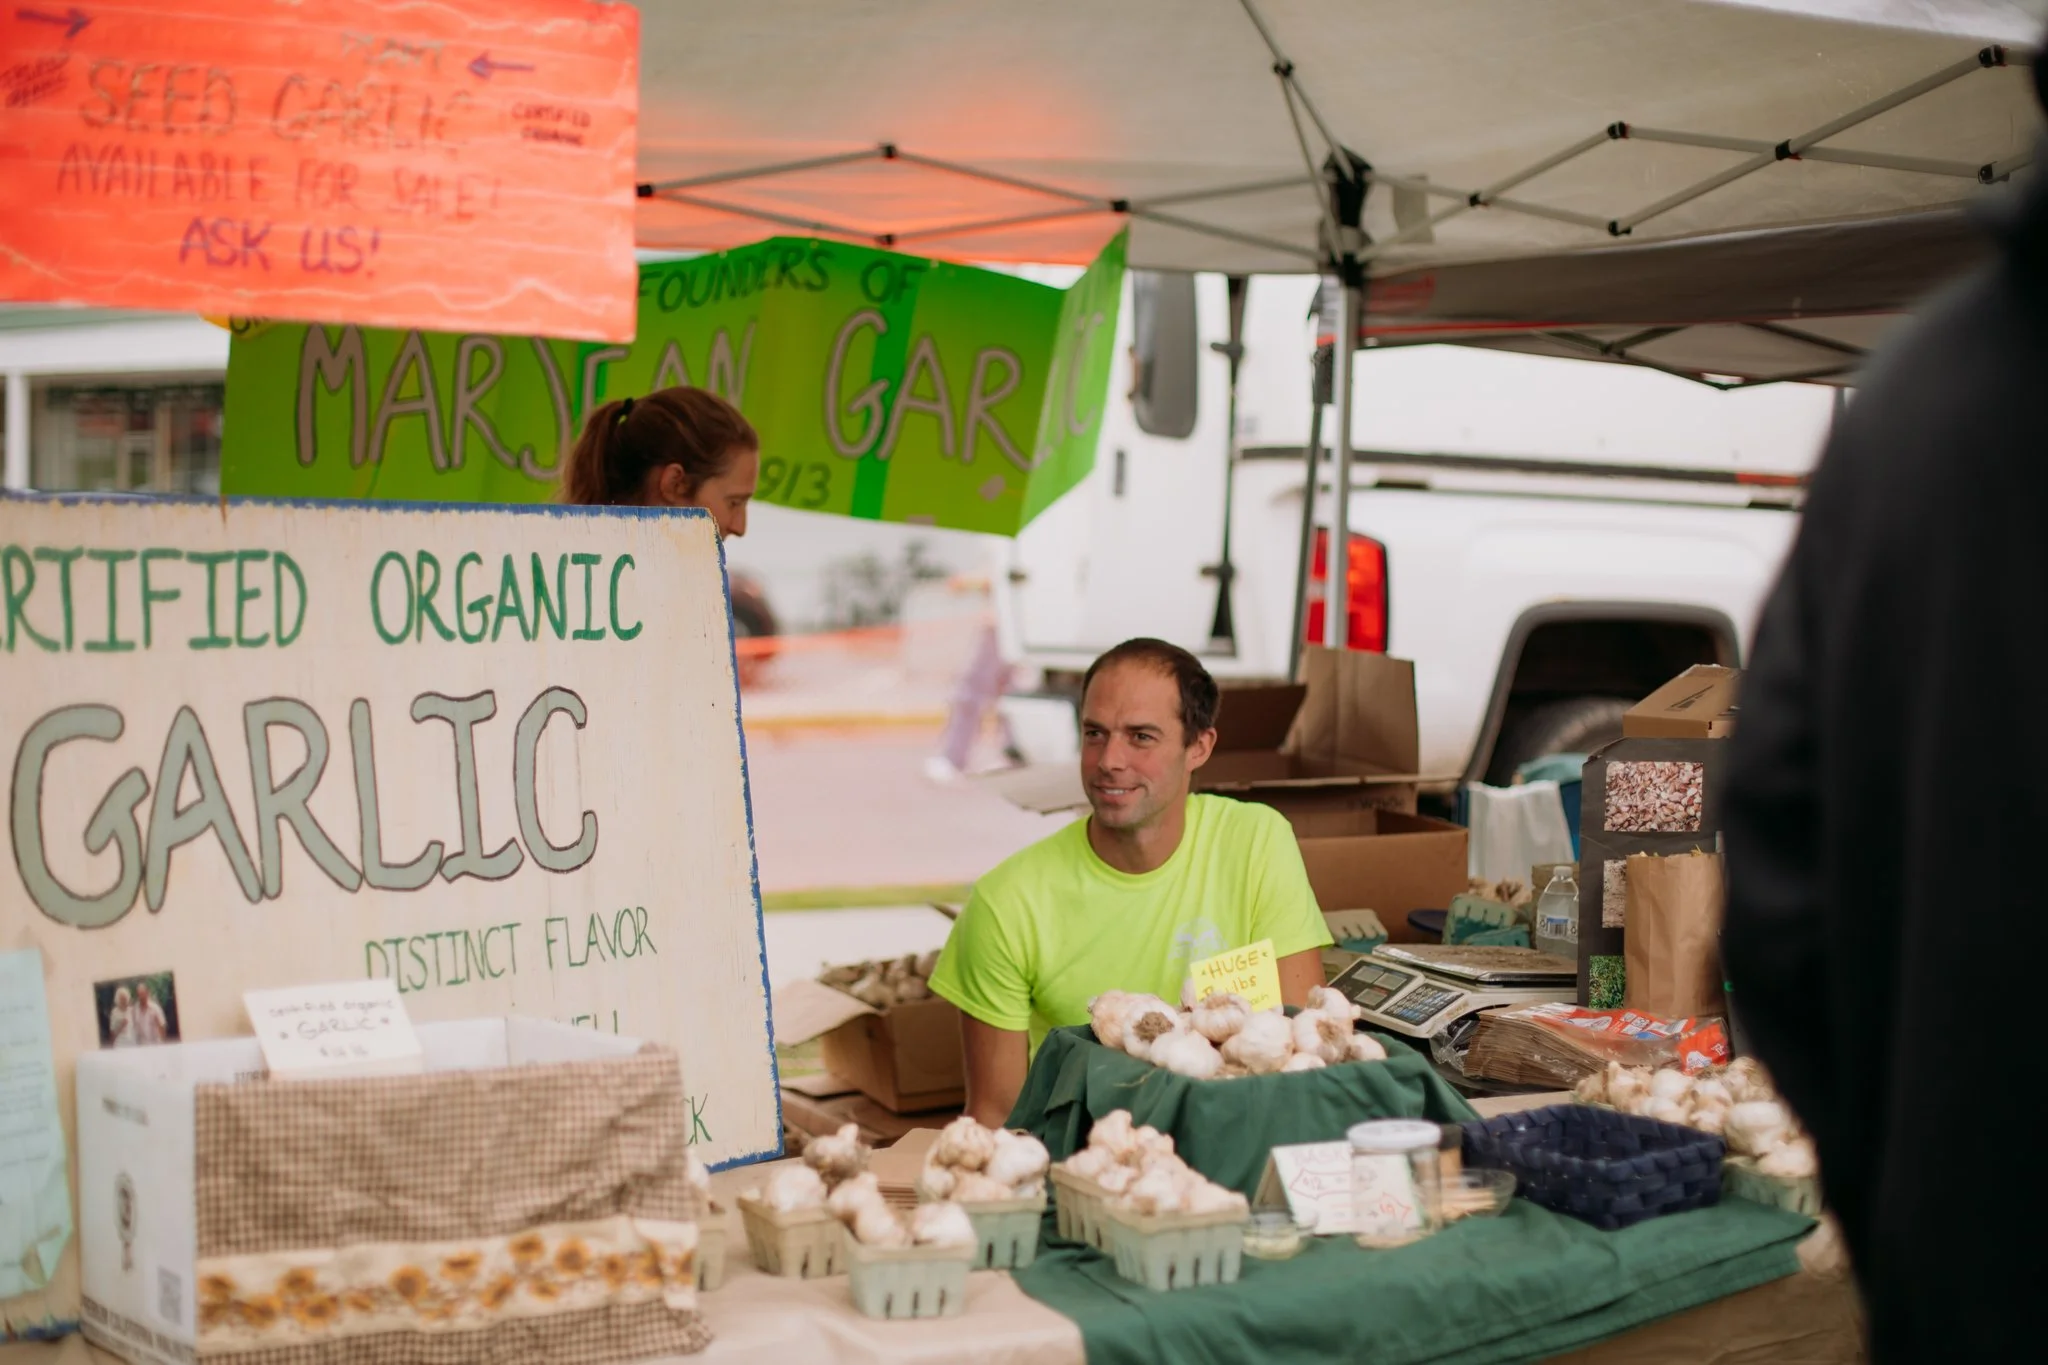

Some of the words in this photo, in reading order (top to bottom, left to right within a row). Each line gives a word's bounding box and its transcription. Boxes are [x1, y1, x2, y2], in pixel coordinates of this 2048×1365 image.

[79, 58, 239, 137] SEED
[56, 143, 270, 203] AVAILABLE
[294, 158, 362, 211] FOR
[178, 216, 272, 272] ASK
[300, 224, 382, 279] US!
[638, 247, 836, 313] FOUNDERS
[861, 260, 927, 304] OF
[370, 550, 643, 645] ORGANIC
[11, 686, 598, 930] GARLIC
[365, 923, 521, 993] DISTINCT
[544, 905, 658, 972] FLAVOR
[1207, 950, 1259, 979] HUGE
[297, 1017, 377, 1041] GARLIC
